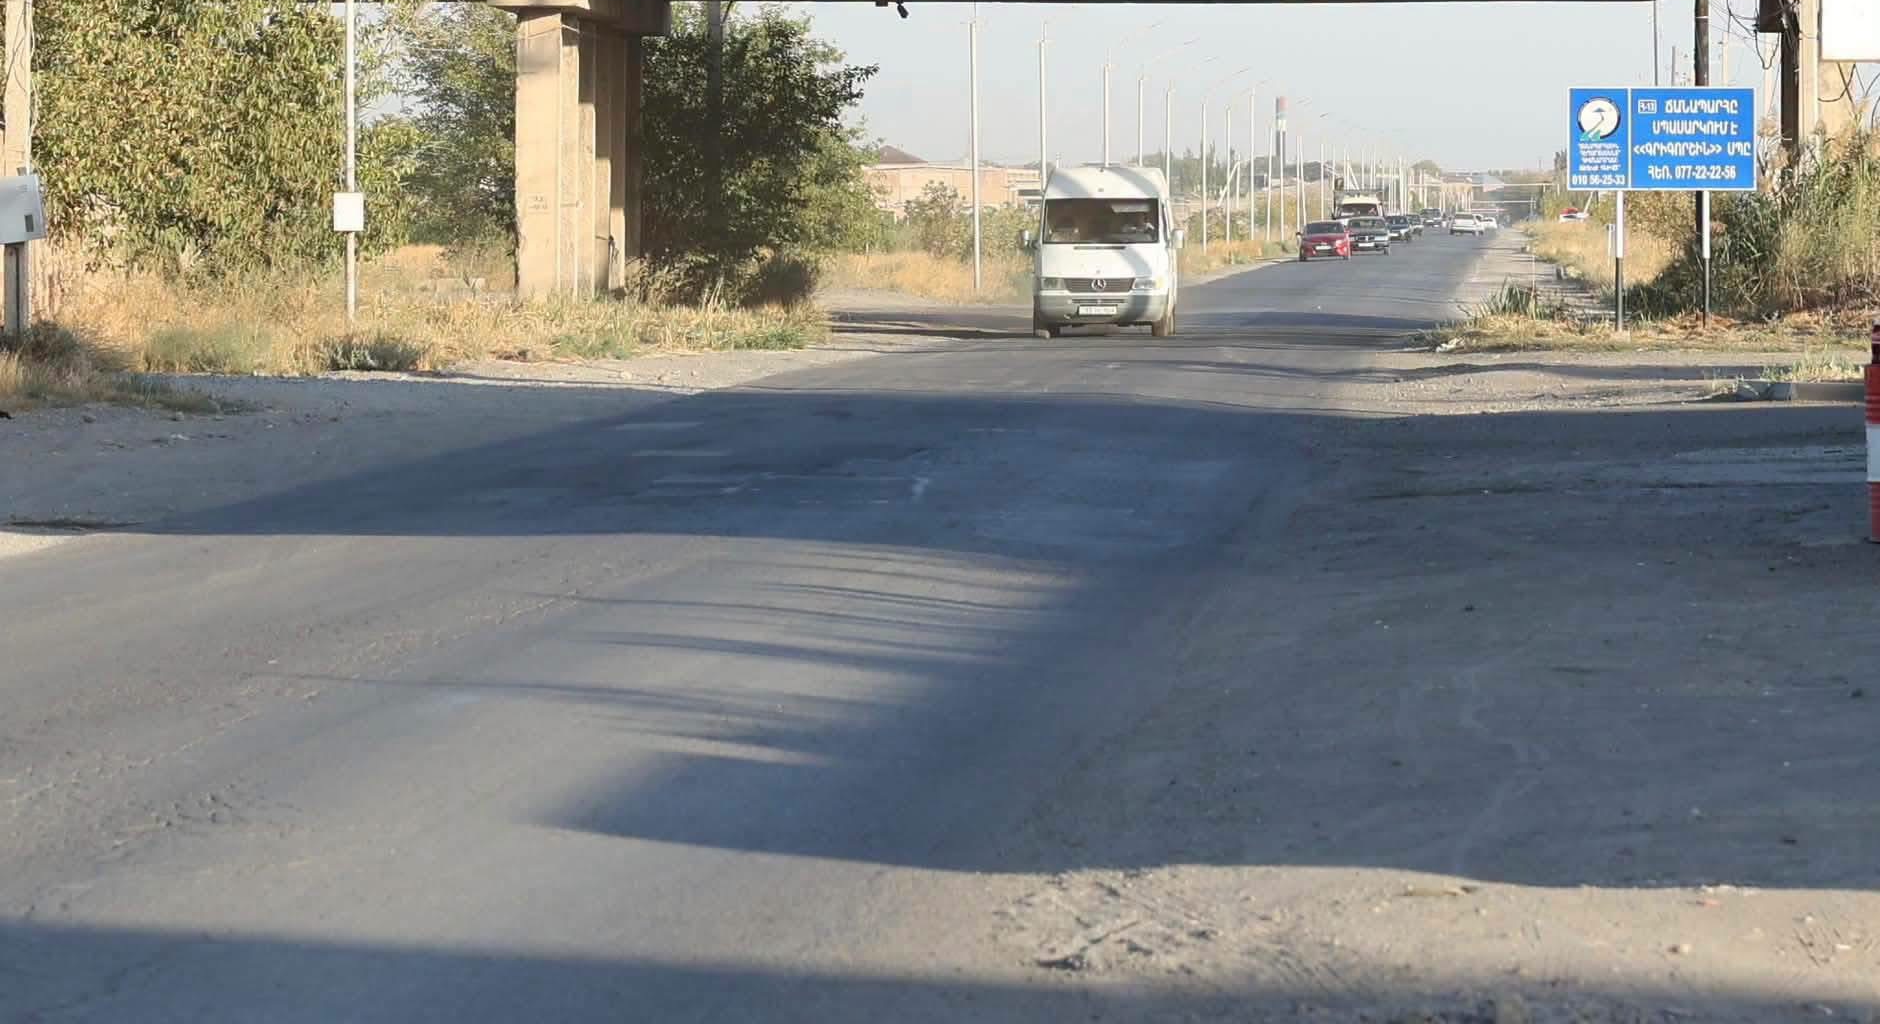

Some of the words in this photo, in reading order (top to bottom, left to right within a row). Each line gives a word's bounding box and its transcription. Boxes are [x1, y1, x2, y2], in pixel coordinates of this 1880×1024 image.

[1665, 99, 1738, 114] ՃԱՆԱՊԱՐՀԸ
[1652, 120, 1729, 135] ՍՊԱՍԱՐԿՈՒՄ
[1731, 120, 1738, 135] Է
[1727, 141, 1752, 156] ՍՊԸ
